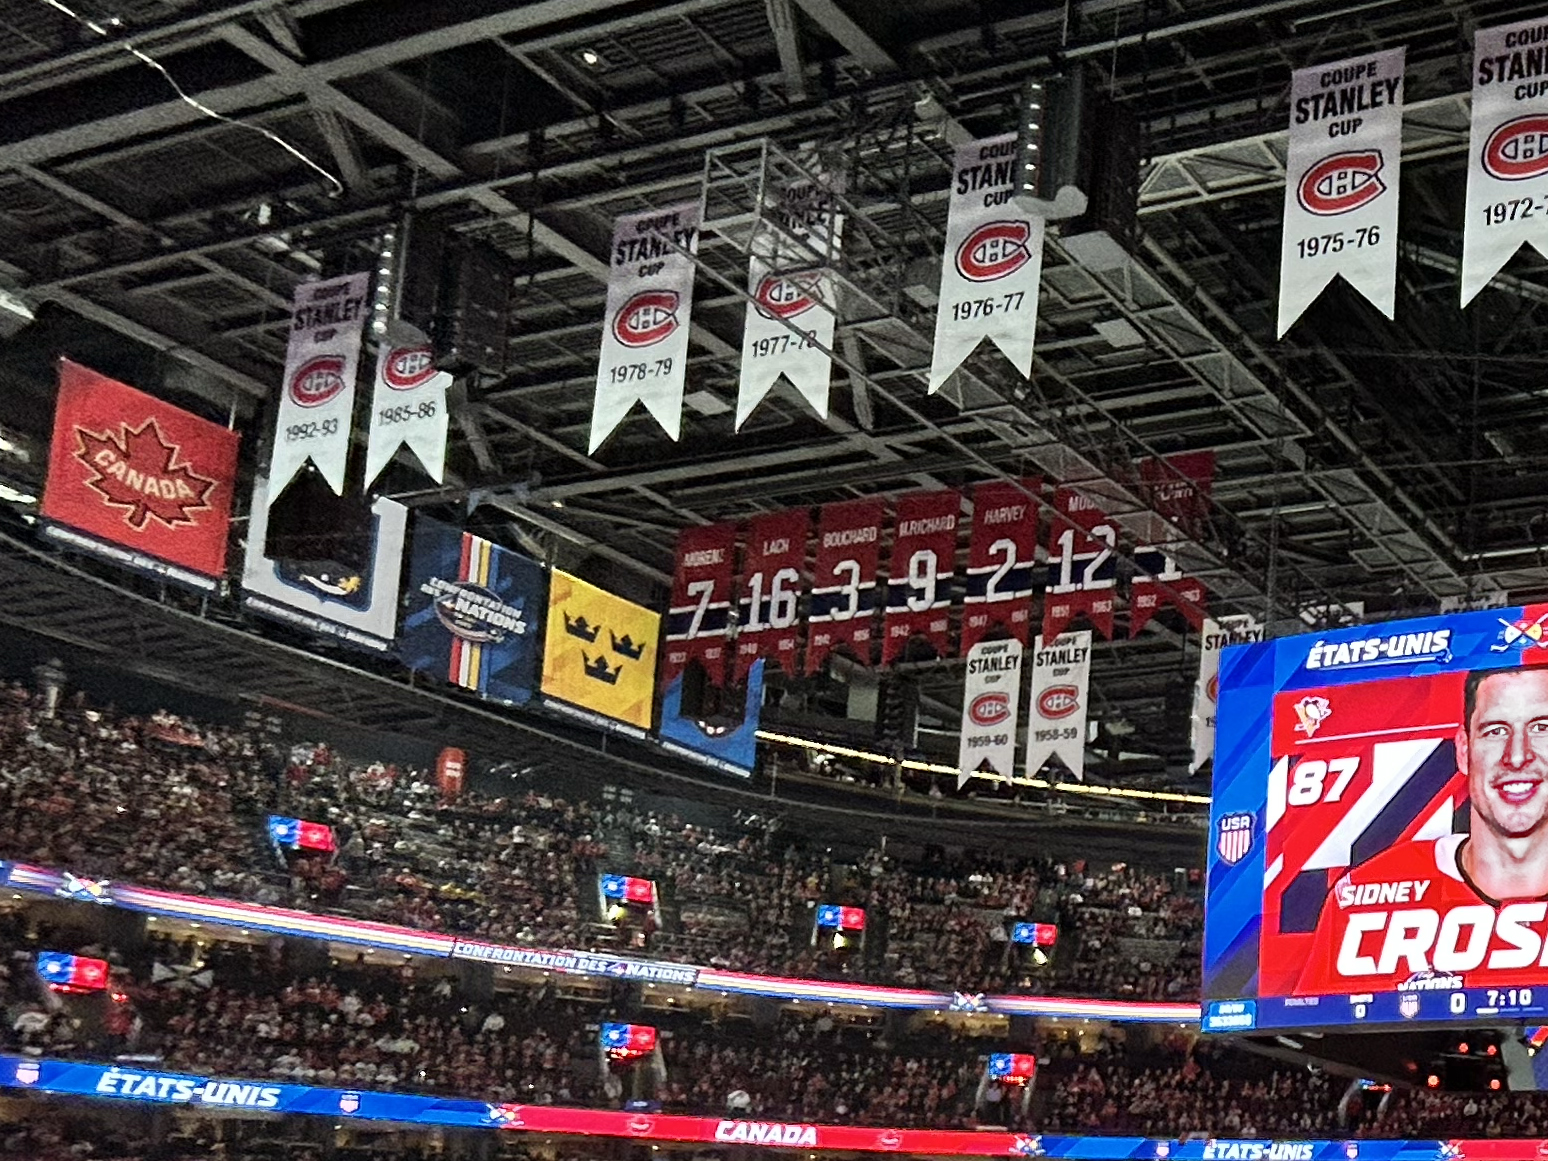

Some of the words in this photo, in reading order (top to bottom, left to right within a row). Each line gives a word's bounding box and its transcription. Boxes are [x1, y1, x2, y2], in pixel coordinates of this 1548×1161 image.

[1320, 61, 1377, 88] COUPE
[1294, 76, 1401, 125] STANLEY
[1328, 118, 1363, 138] CUP
[1297, 225, 1381, 259] 1975-76
[951, 292, 1026, 321] 1976-77
[609, 359, 673, 385] 1978-79
[93, 448, 196, 500] CANADA
[984, 504, 1027, 525] HARVEY
[763, 538, 790, 557] LACH
[1053, 524, 1116, 595] 12
[907, 549, 937, 612] 9
[986, 538, 1016, 603] 2
[743, 567, 799, 632] 16
[830, 559, 860, 621] 3
[687, 579, 715, 640] 7
[968, 654, 1020, 675] STANLEY
[1036, 647, 1088, 667] STANLEY
[1306, 629, 1451, 670] ÉTATS-UNIS
[1288, 756, 1360, 806] 87
[1222, 815, 1250, 831] USA
[1339, 879, 1431, 907] SIDNEY
[454, 942, 577, 969] CONFRONTATION
[578, 959, 606, 972] DES
[627, 964, 696, 982] NATIONS
[1451, 993, 1467, 1014] 0
[1487, 989, 1532, 1007] 7:10
[96, 1065, 281, 1109] ÉTATS-UNIS
[715, 1120, 817, 1147] CANADA
